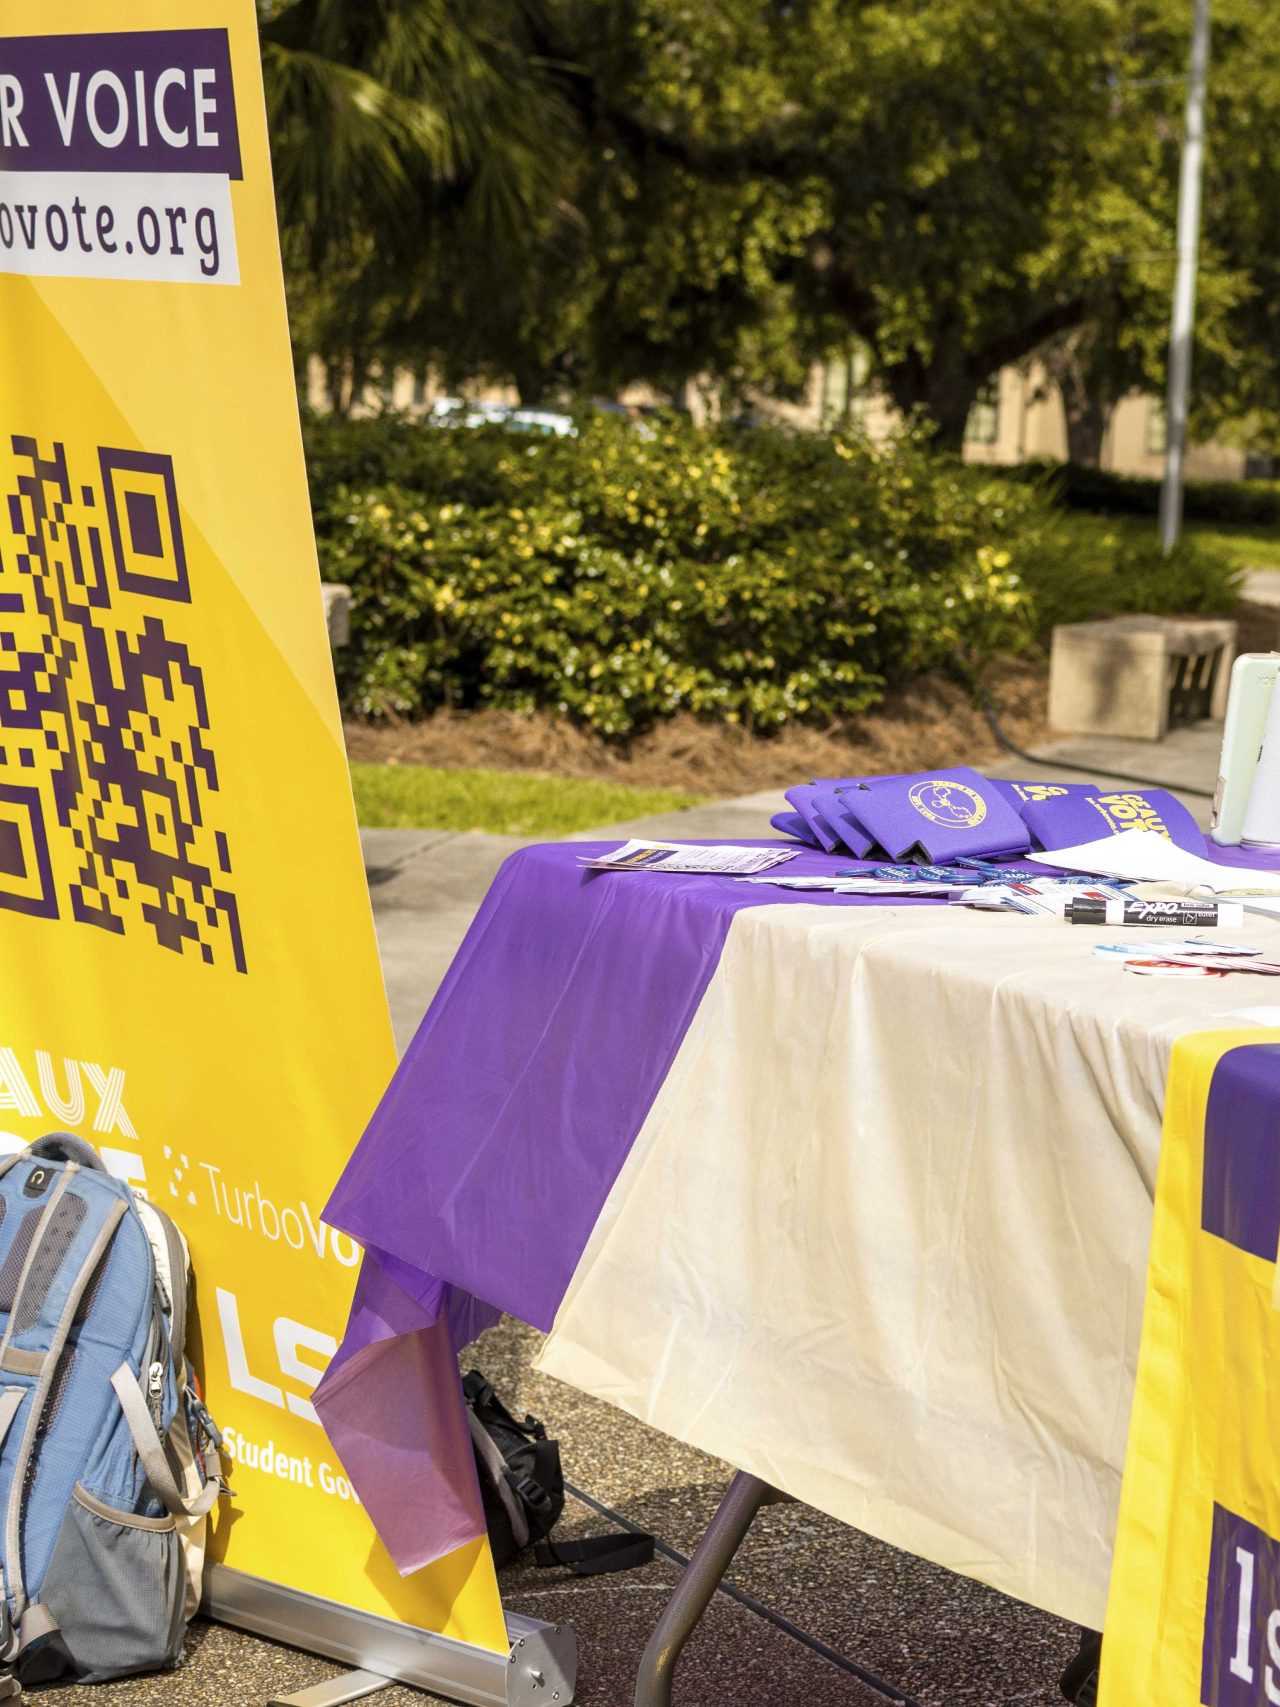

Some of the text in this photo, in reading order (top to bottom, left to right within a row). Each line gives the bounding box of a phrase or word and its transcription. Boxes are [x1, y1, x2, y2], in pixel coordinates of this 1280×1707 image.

[0, 68, 219, 148] R VOICE
[0, 196, 220, 276] ovote.org
[1121, 794, 1173, 843] GEAU
[1127, 900, 1178, 919] EXPO
[1146, 914, 1159, 923] dry
[222, 1426, 315, 1488] Student
